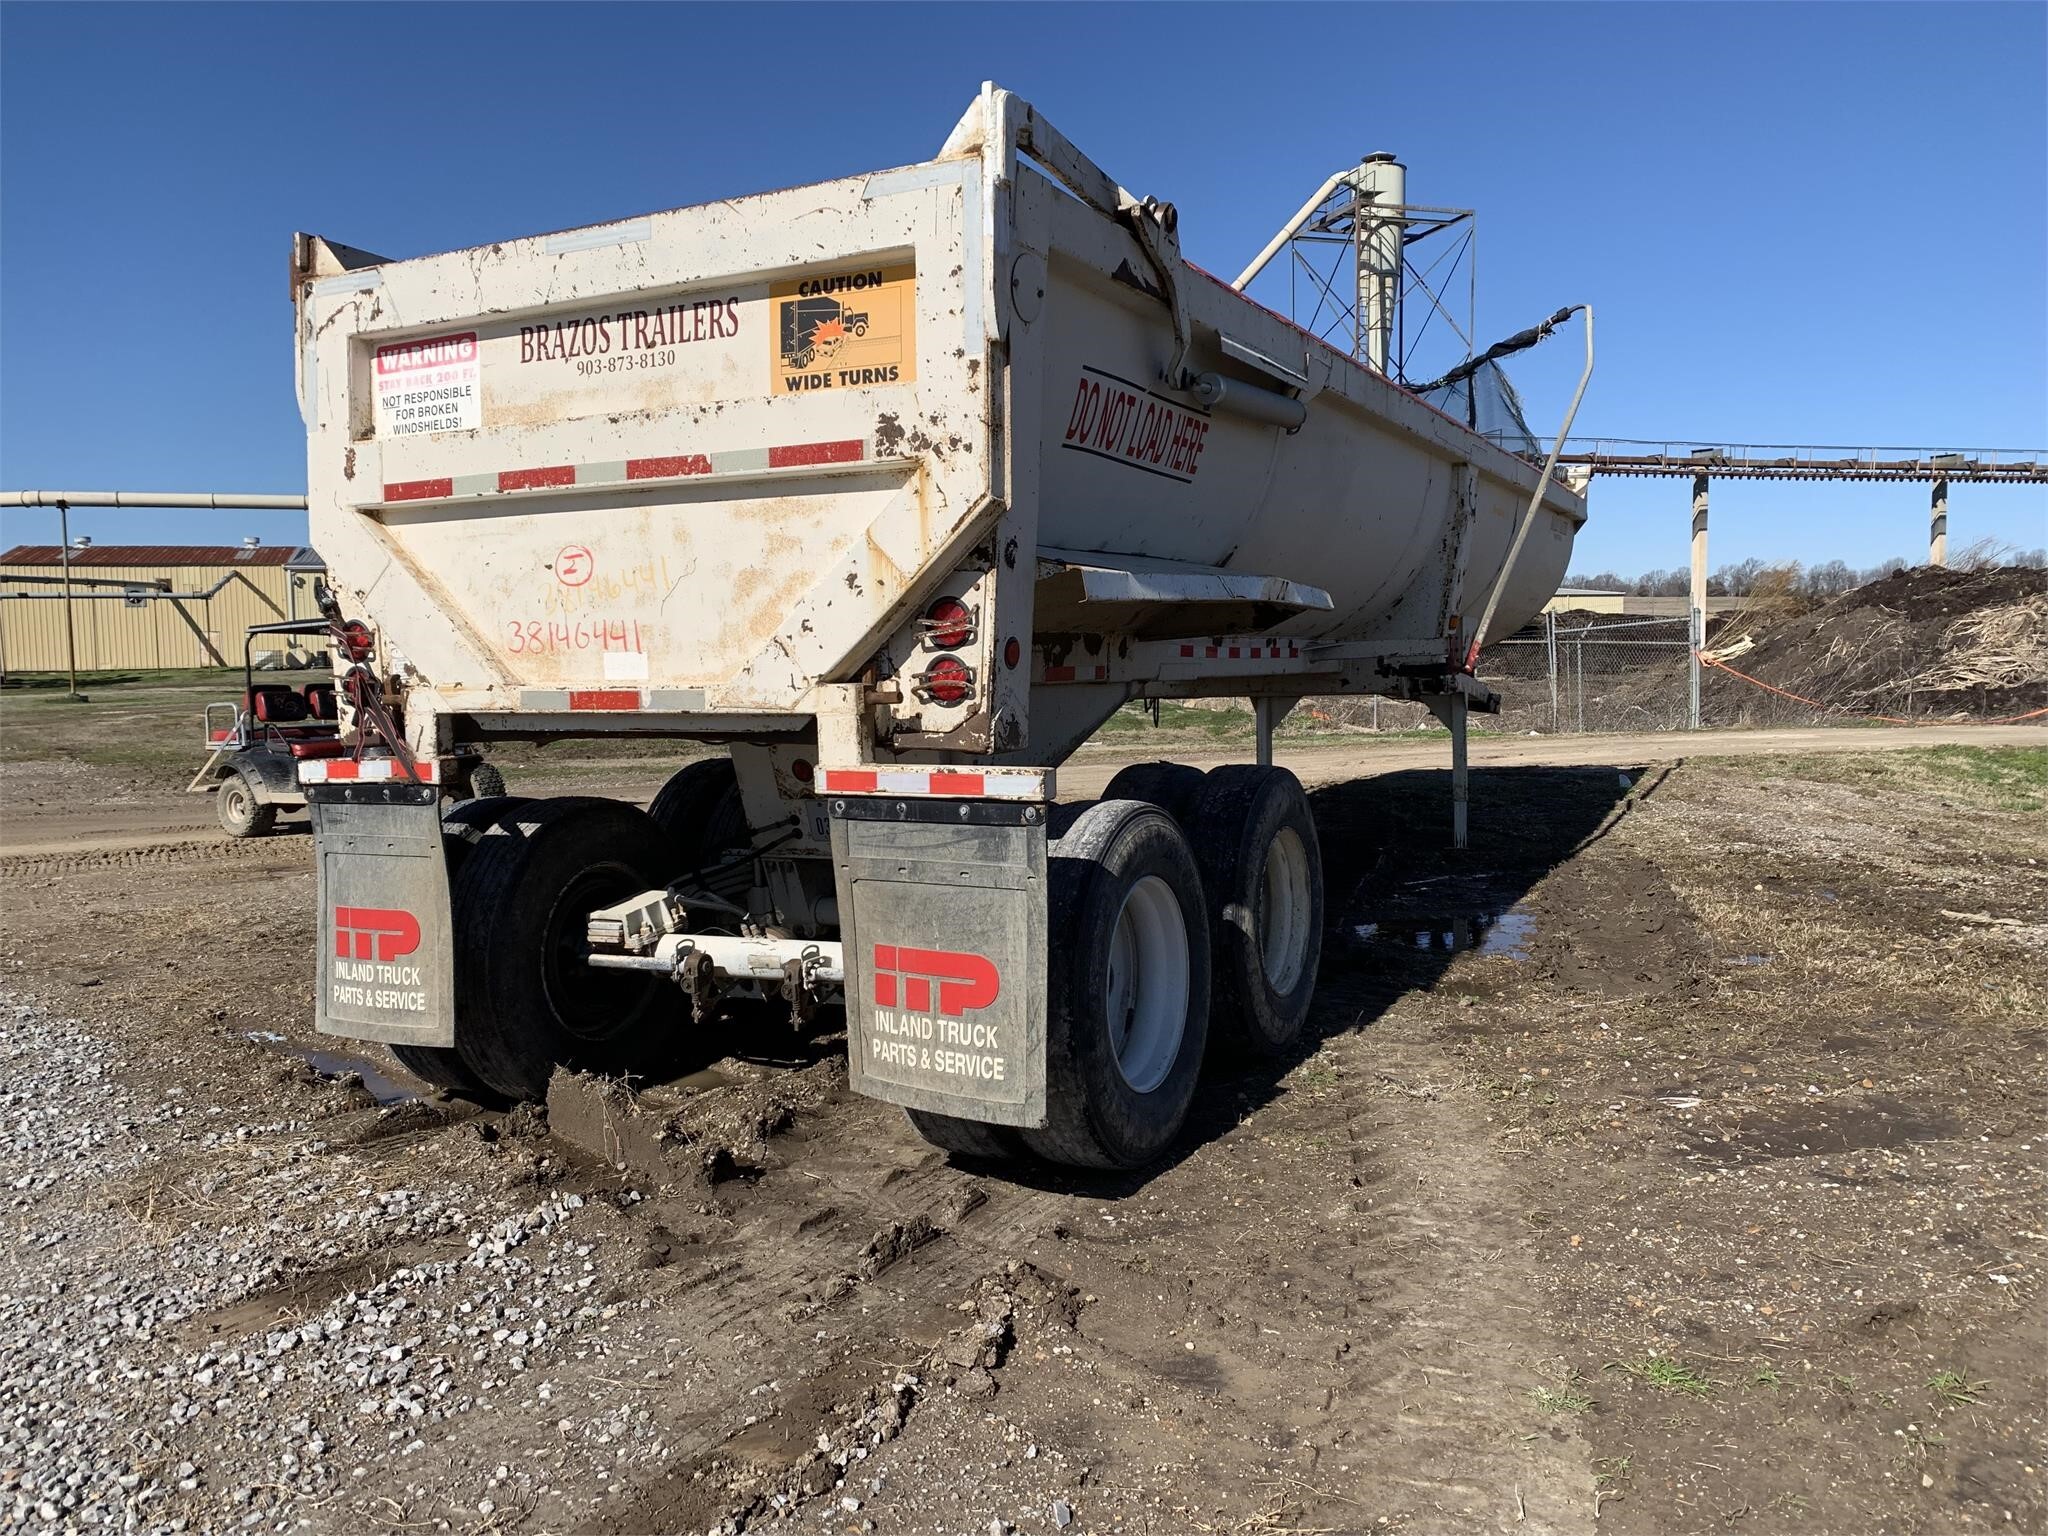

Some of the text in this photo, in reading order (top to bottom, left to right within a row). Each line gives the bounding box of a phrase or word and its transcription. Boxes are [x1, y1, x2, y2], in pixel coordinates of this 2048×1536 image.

[799, 271, 882, 297] CAUTION
[520, 297, 739, 364] BRAZOS TRAILERS
[380, 338, 472, 370] WARNING
[577, 349, 675, 376] 903-873-8130
[379, 377, 401, 392] STAY
[437, 370, 459, 382] 200
[785, 366, 899, 391] WIDE TURNS
[382, 385, 472, 409] NOT RESPONSIBLE
[396, 403, 458, 420] FOR BROKEN
[393, 417, 462, 435] WINDSHIELDS!
[1065, 377, 1209, 474] DO NOT LOAD HERE
[507, 618, 643, 655] 38146441
[336, 961, 421, 986] INLAND TRUCK
[334, 985, 426, 1011] PARTS & SERVICE
[875, 1010, 998, 1049] INLAND TRUCK
[872, 1038, 1005, 1081] PARTS & SERVICE
